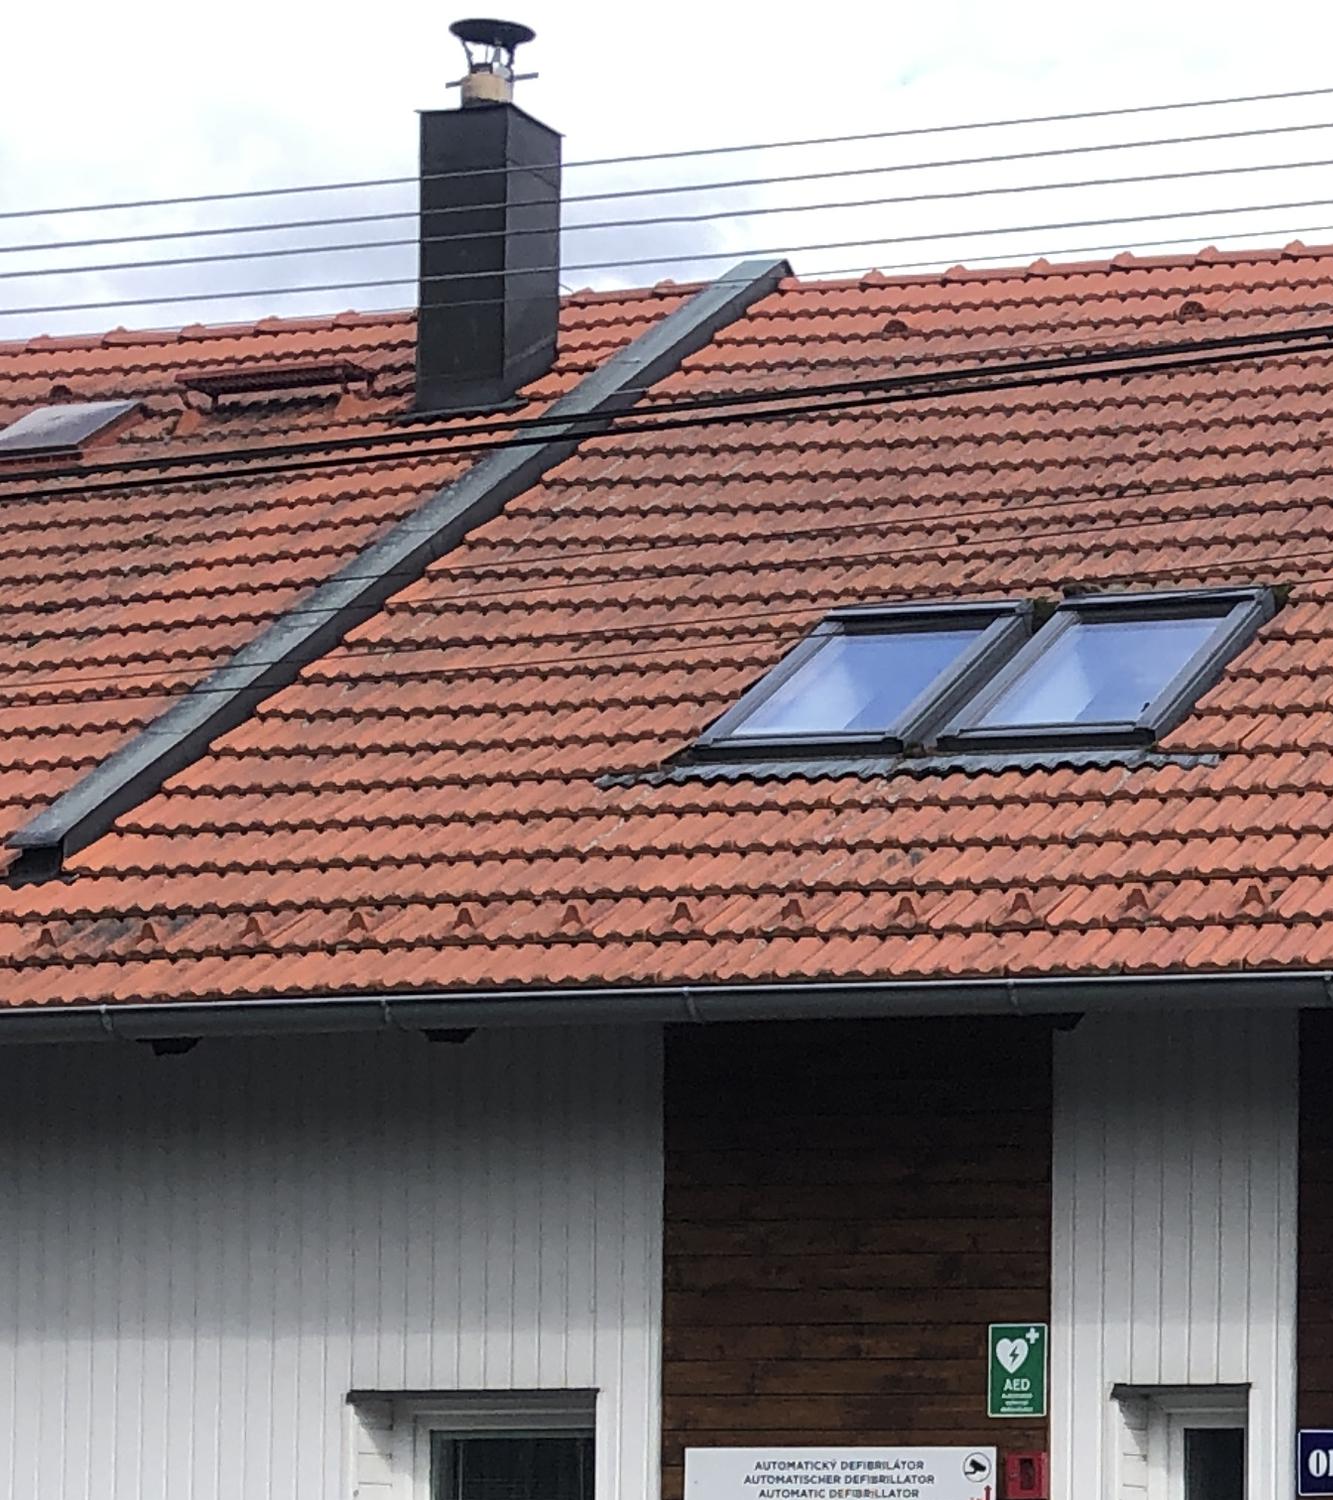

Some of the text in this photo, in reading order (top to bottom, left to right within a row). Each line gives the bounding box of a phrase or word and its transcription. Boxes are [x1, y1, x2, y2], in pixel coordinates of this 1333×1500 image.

[1003, 1378, 1030, 1391] AED
[754, 1458, 924, 1471] AUTOMATICKÝ DEFIBRILÁTOR
[744, 1474, 934, 1485] AUTOMATISCHER DEFIBRILLATOR
[758, 1488, 919, 1499] AUTOMATIC DEFIBRILLATOR
